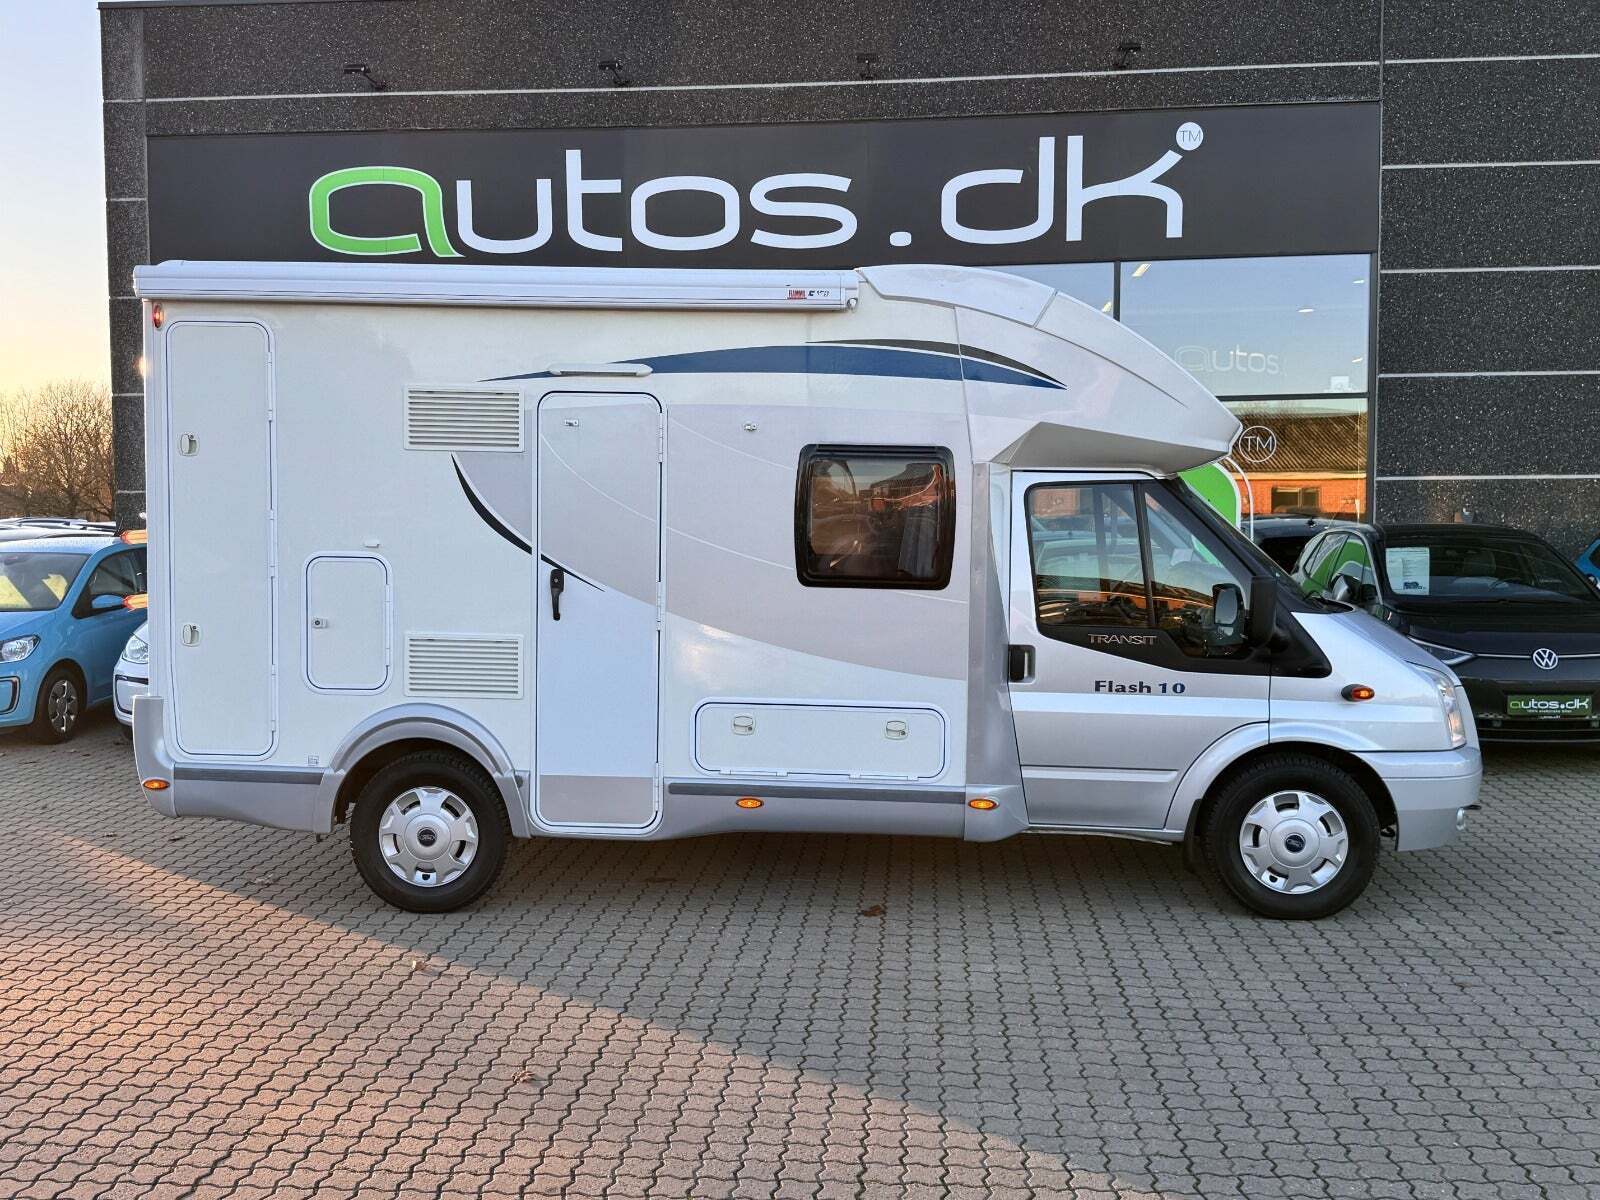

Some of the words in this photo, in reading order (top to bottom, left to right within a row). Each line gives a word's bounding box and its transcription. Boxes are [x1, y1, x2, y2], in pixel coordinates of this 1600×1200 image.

[1179, 129, 1202, 143] TM
[308, 135, 1184, 258] autos.dk
[1243, 434, 1273, 452] TM
[1087, 633, 1158, 646] TRANSIT
[1094, 680, 1152, 694] Flash
[1158, 682, 1186, 694] 10
[1509, 698, 1590, 709] autos.dk
